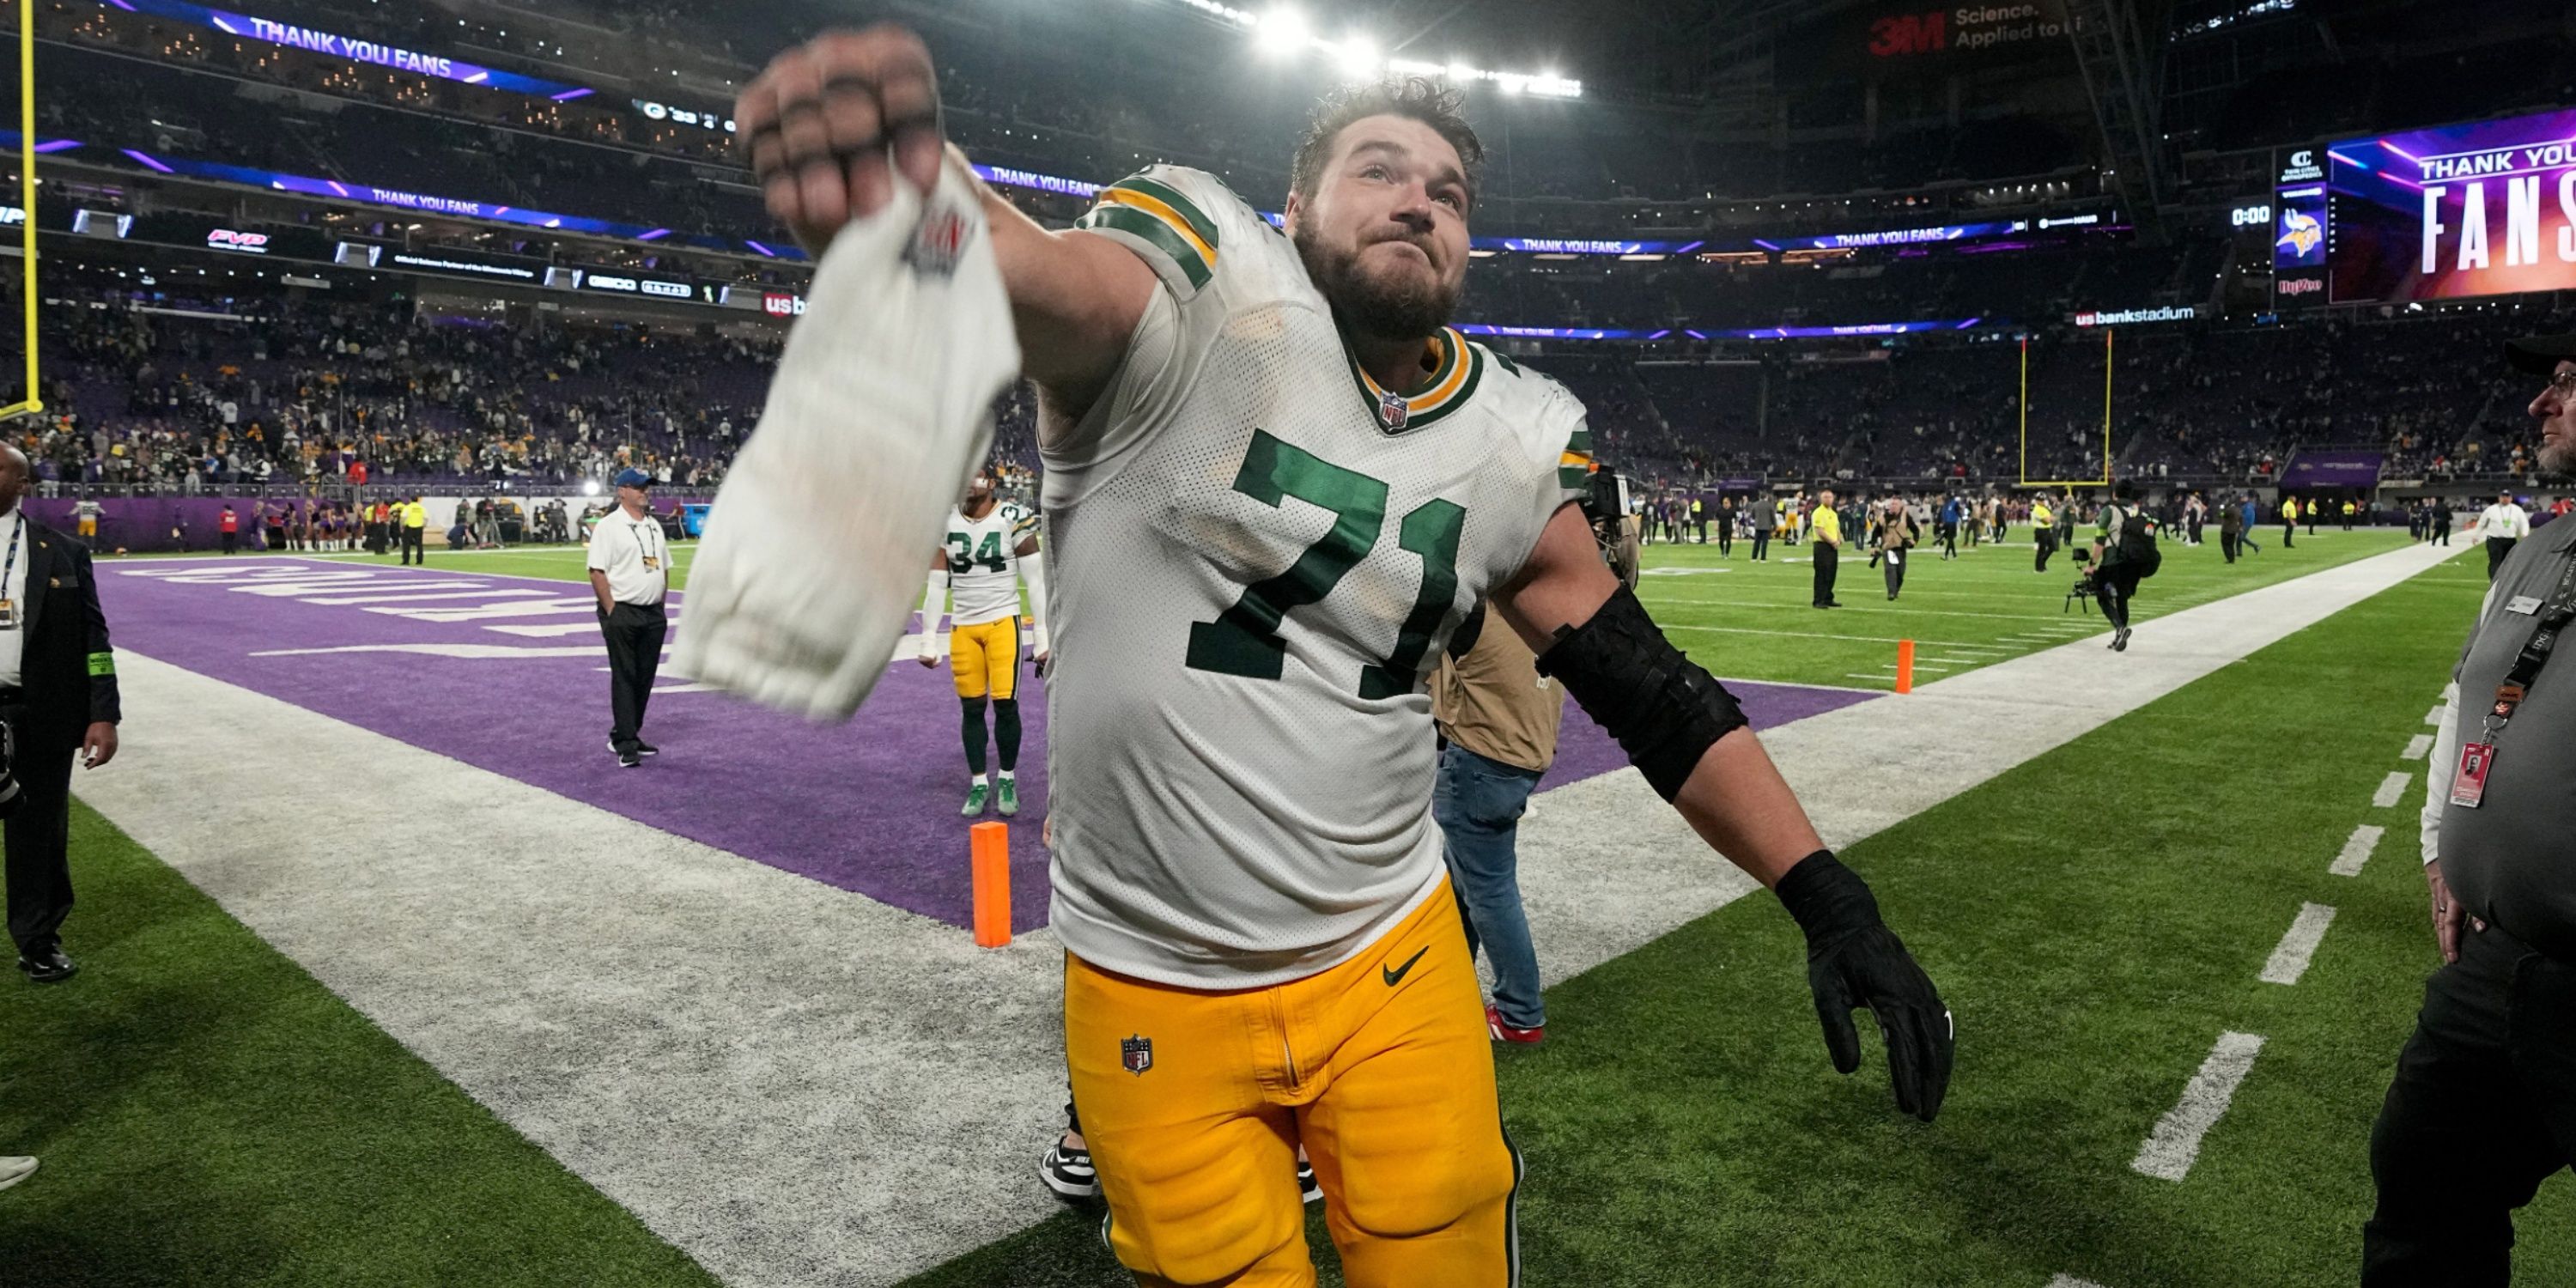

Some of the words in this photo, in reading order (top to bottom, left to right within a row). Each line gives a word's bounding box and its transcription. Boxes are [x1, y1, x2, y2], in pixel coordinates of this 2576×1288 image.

[1955, 4, 2039, 26] Science.
[1869, 12, 1946, 56] 3M
[1955, 23, 2033, 50] Applied
[2038, 23, 2059, 38] to
[250, 17, 336, 54] THANK
[341, 37, 388, 64] YOU
[393, 49, 451, 77] FANS
[2418, 152, 2513, 179] THANK
[2525, 144, 2576, 167] YOU
[992, 167, 1037, 188] THANK
[1039, 175, 1066, 192] YOU
[372, 188, 417, 206] THANK
[419, 196, 445, 210] YOU
[447, 199, 479, 215] FANS
[2233, 205, 2270, 226] 0:00
[2421, 170, 2576, 274] FANS
[208, 228, 267, 246] FVP
[1522, 238, 1563, 251] THANK
[1564, 240, 1589, 252] YOU
[1591, 240, 1622, 253] FANS
[1835, 234, 1880, 247] THANK
[1881, 230, 1908, 243] YOU
[1911, 227, 1945, 241] FANS
[1502, 326, 1525, 336] THANK
[1523, 327, 1539, 337] YOU
[1538, 328, 1555, 337] FANS
[1832, 325, 1857, 335] THANK
[1856, 324, 1874, 334] YOU
[1874, 323, 1893, 333] FANS
[947, 532, 1007, 574] 34
[1185, 428, 1467, 701] 71
[1125, 1050, 1149, 1067] NFL
